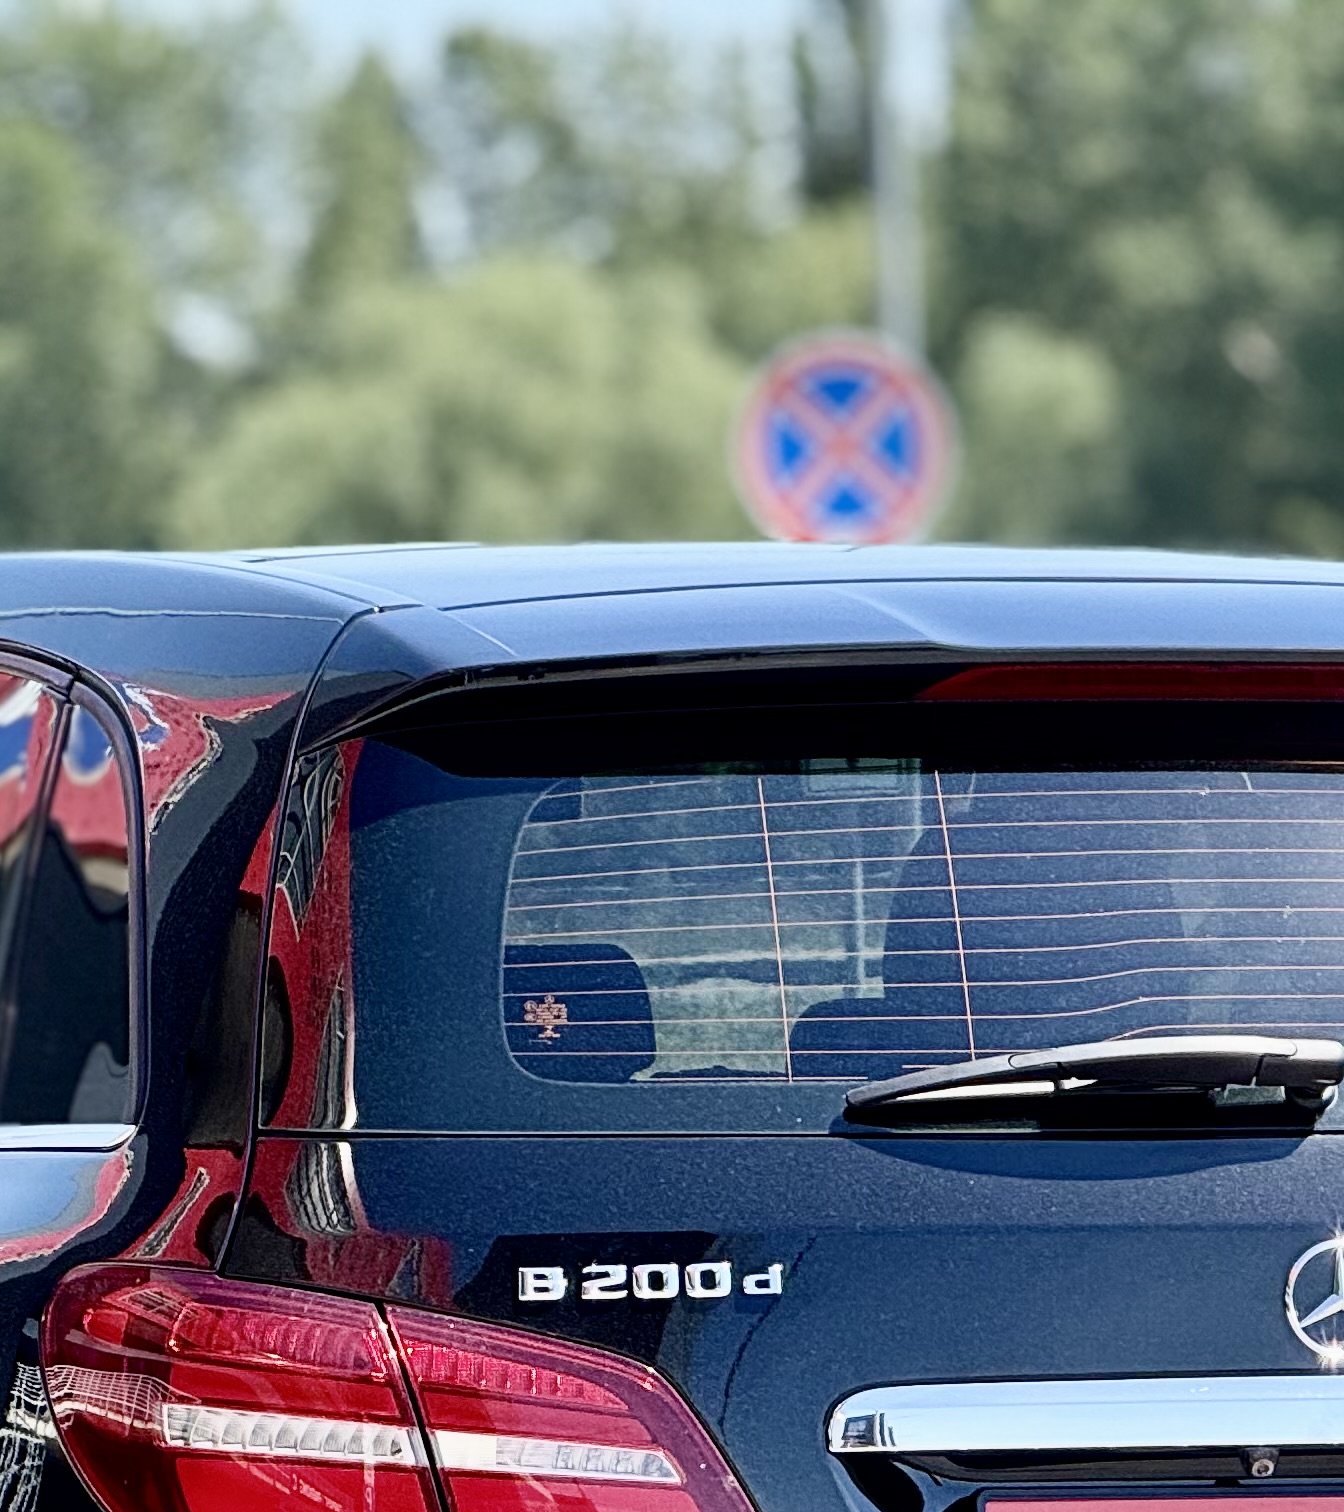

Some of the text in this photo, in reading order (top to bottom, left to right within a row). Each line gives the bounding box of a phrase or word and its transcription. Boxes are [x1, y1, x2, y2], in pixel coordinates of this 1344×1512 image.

[518, 1260, 784, 1301] B 200 d
